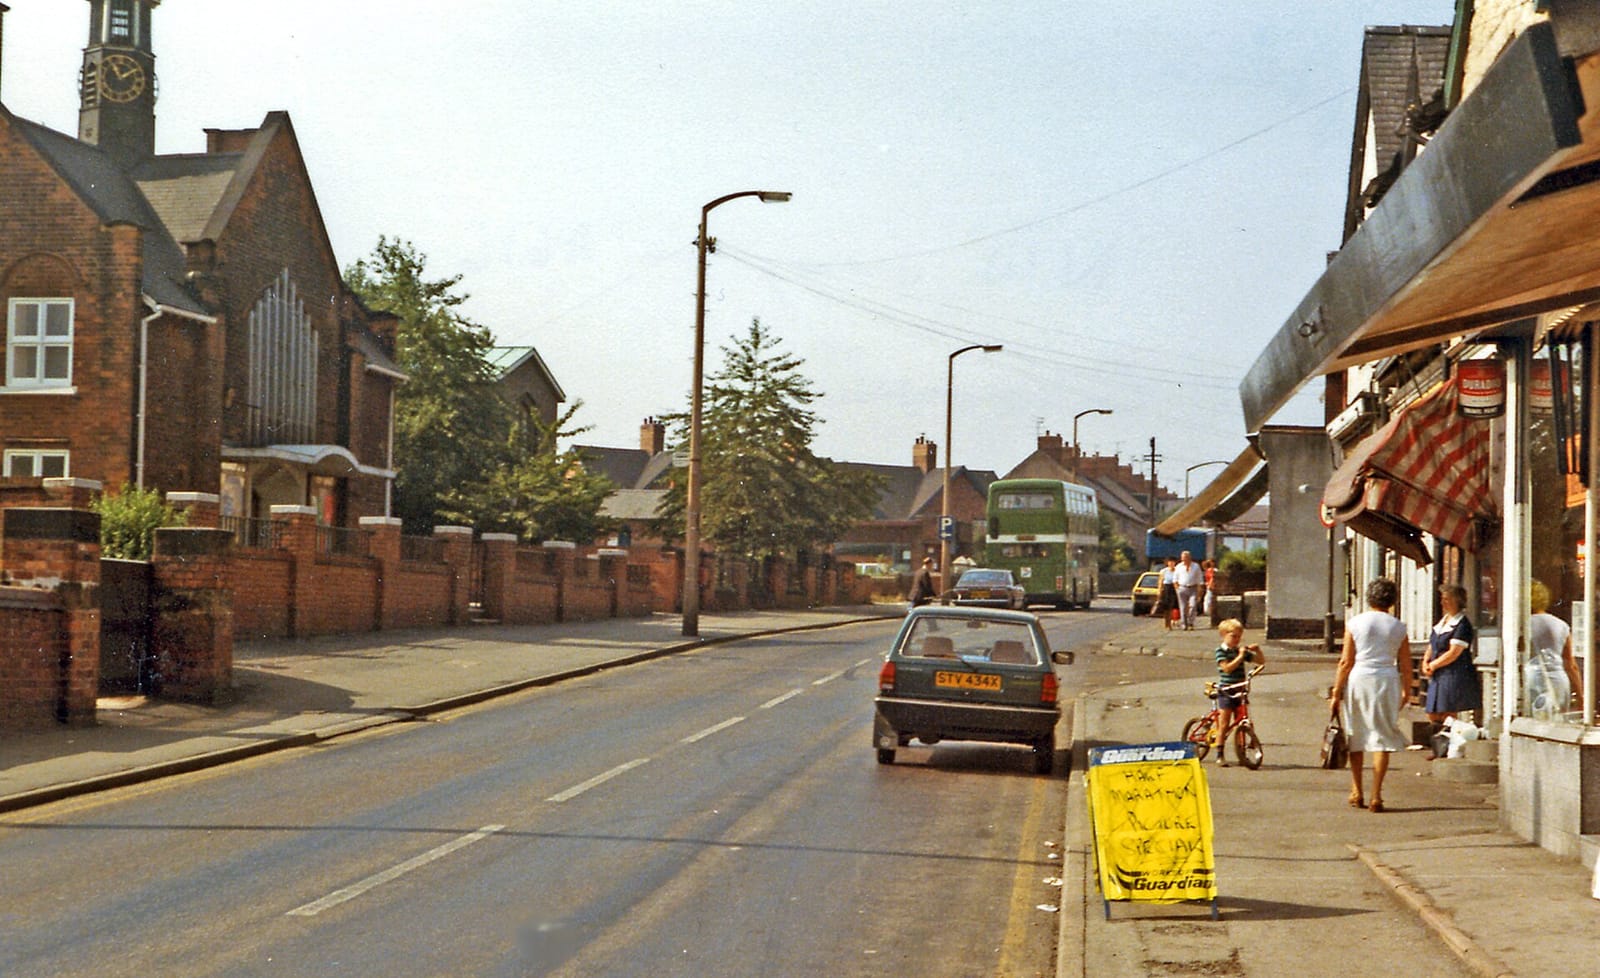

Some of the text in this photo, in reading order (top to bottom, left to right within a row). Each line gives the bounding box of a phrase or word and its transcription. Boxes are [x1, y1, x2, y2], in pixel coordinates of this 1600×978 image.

[942, 517, 952, 531] P
[938, 672, 998, 687] STV 434X
[1101, 746, 1185, 764] Guardian
[1133, 875, 1212, 891] Guardian
